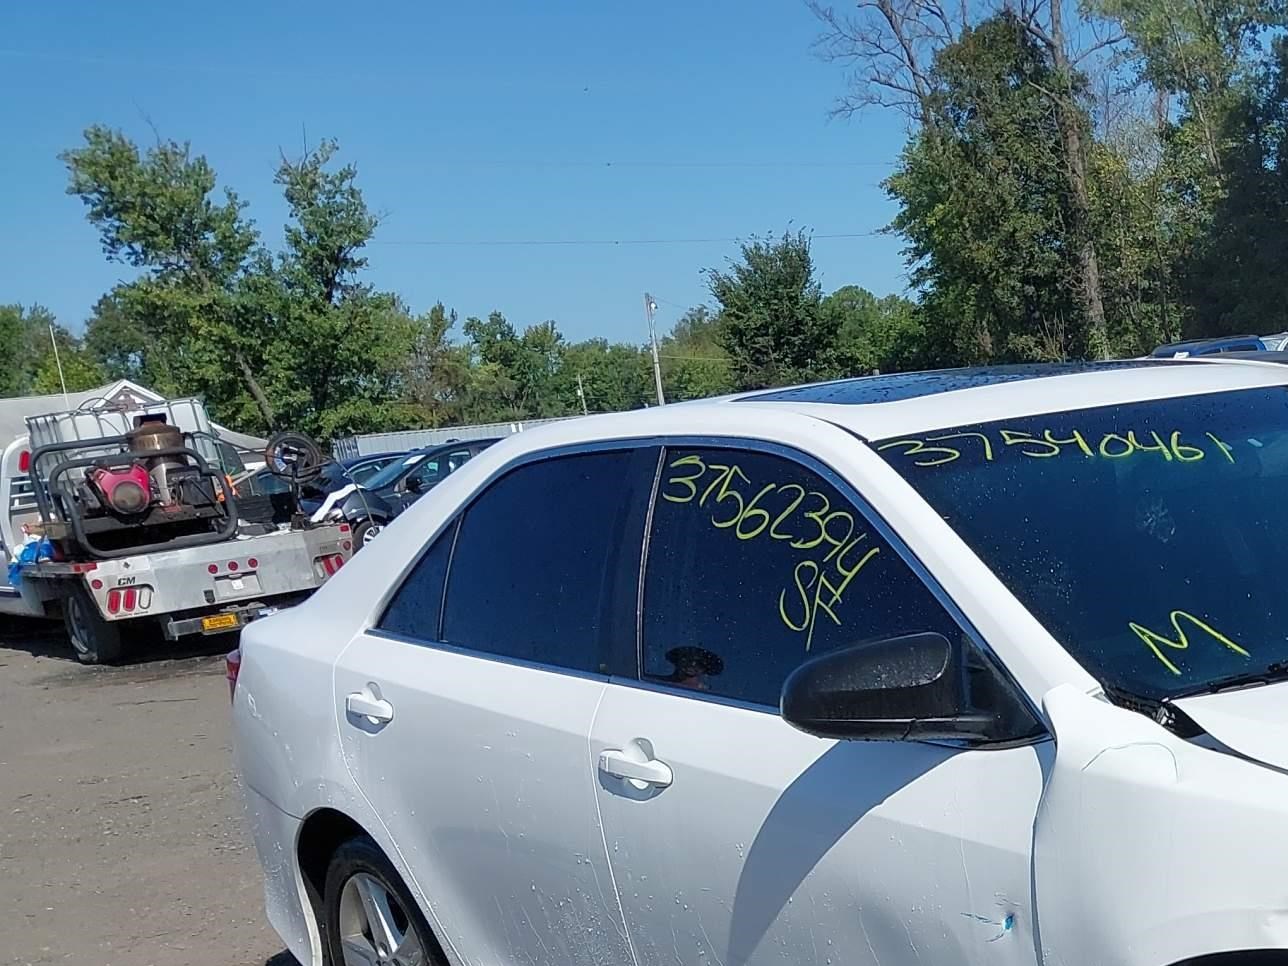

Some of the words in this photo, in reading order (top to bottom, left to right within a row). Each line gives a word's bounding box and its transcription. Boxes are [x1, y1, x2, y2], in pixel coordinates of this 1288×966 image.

[877, 429, 1236, 467] 37540461
[662, 455, 880, 607] 37562394
[1128, 610, 1251, 675] M
